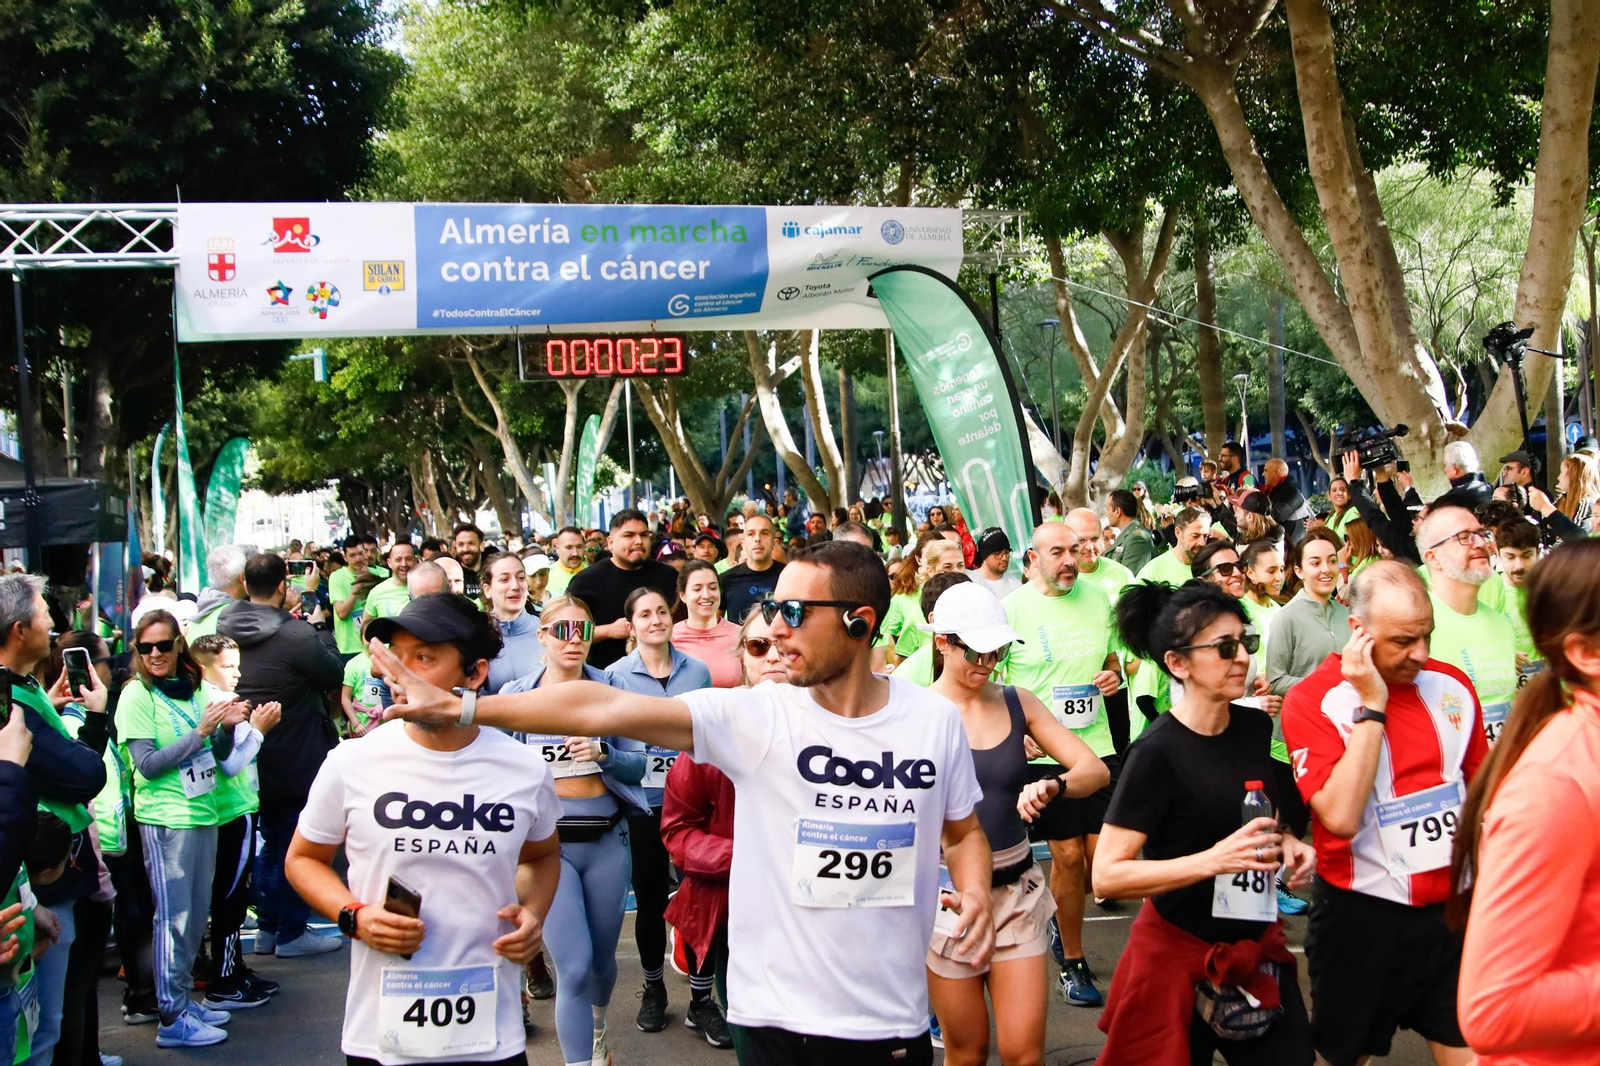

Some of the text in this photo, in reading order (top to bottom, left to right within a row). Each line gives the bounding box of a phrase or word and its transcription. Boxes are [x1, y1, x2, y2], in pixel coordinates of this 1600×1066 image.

[439, 218, 748, 245] Almería en marcha
[804, 222, 863, 238] cajamar
[905, 226, 952, 235] UNIVERSIDAD
[368, 263, 400, 276] SOLAN
[441, 253, 711, 283] contra el cáncer
[806, 262, 845, 271] MICHELIN
[368, 275, 400, 283] DE CABRAS
[805, 282, 831, 292] Toyota
[193, 286, 249, 299] ALMERÍA
[694, 293, 728, 301] asociación
[802, 290, 832, 299] Alborán
[833, 286, 856, 295] Motor
[432, 307, 541, 318] #TodosContraElCáncer
[546, 337, 683, 377] 00:00:23
[1064, 698, 1093, 715] 831
[541, 745, 572, 763] 52
[796, 745, 936, 789] Cooke
[814, 793, 915, 814] ESPAÑA
[373, 791, 515, 833] Cooke
[801, 830, 828, 840] contra
[829, 831, 838, 841] el
[839, 832, 868, 842] cáncer
[1401, 811, 1458, 847] 799
[394, 836, 496, 854] ESPAÑA
[817, 850, 893, 880] 296
[386, 981, 413, 989] contra
[423, 981, 451, 989] cáncer
[402, 995, 476, 1028] 409
